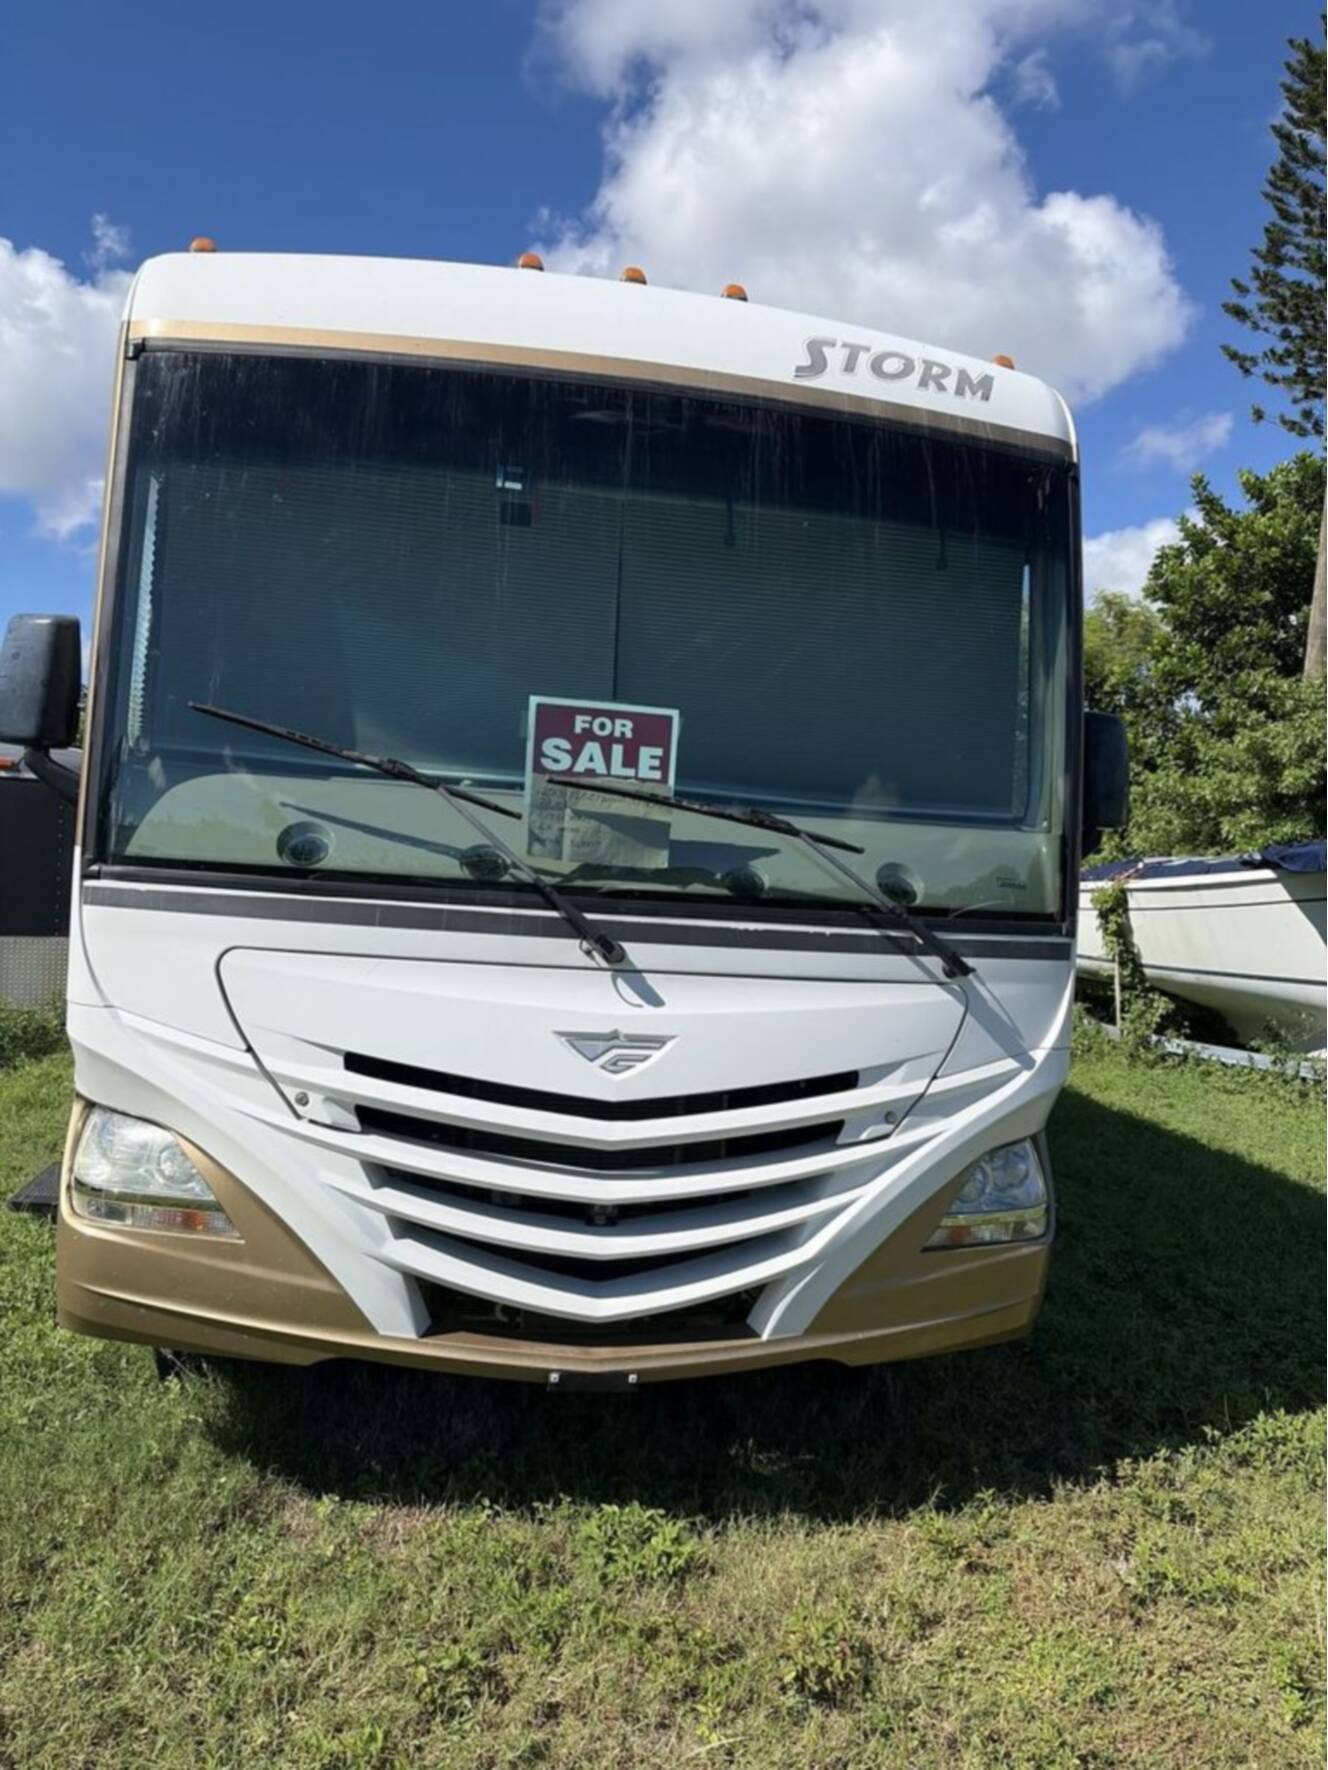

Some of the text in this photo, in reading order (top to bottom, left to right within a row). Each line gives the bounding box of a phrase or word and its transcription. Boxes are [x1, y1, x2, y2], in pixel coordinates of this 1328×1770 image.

[794, 336, 996, 402] STORM
[573, 714, 634, 738] FOR
[540, 737, 664, 780] SALE
